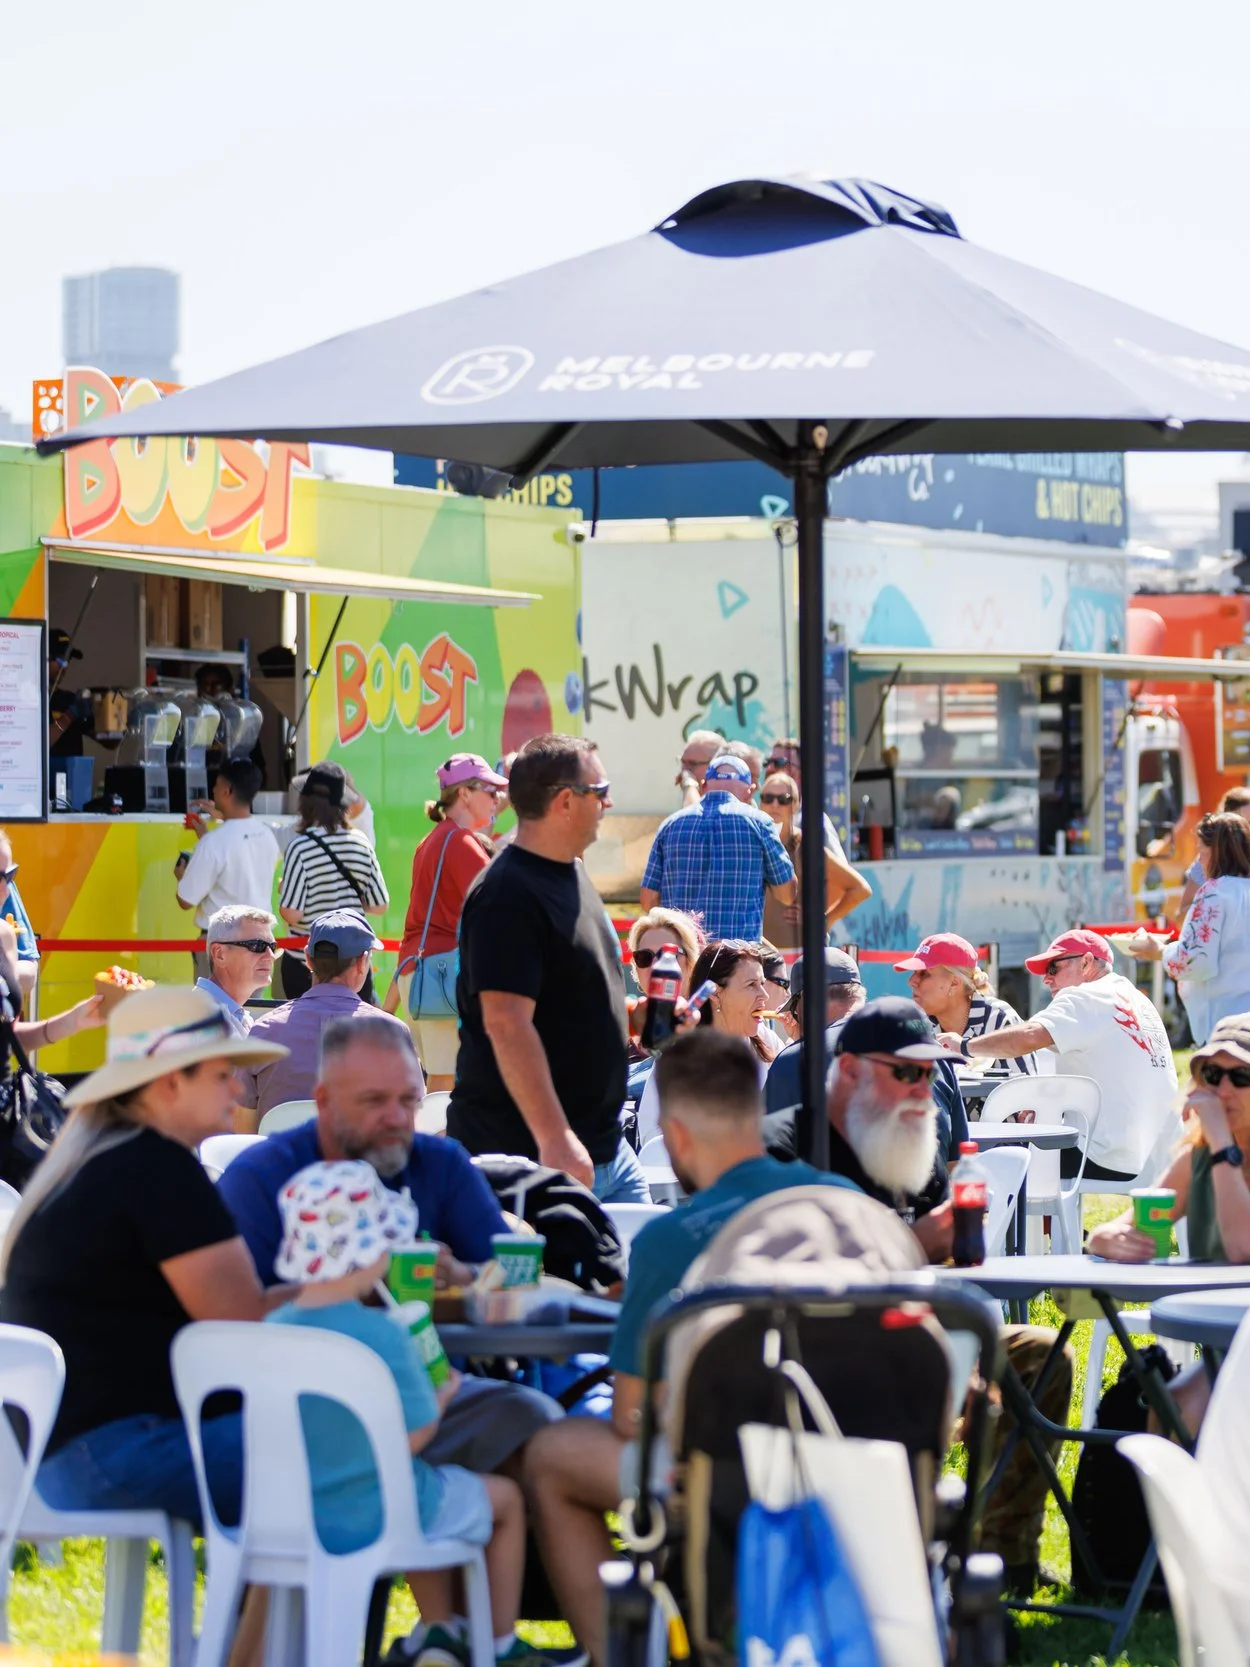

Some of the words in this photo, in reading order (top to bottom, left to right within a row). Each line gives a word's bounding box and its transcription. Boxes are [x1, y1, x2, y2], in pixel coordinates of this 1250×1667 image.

[554, 350, 876, 373] MELBOURNE
[538, 373, 703, 392] ROYAL
[1050, 480, 1079, 521] HOT
[1081, 483, 1122, 527] CHIPS
[335, 630, 478, 748] BOOST
